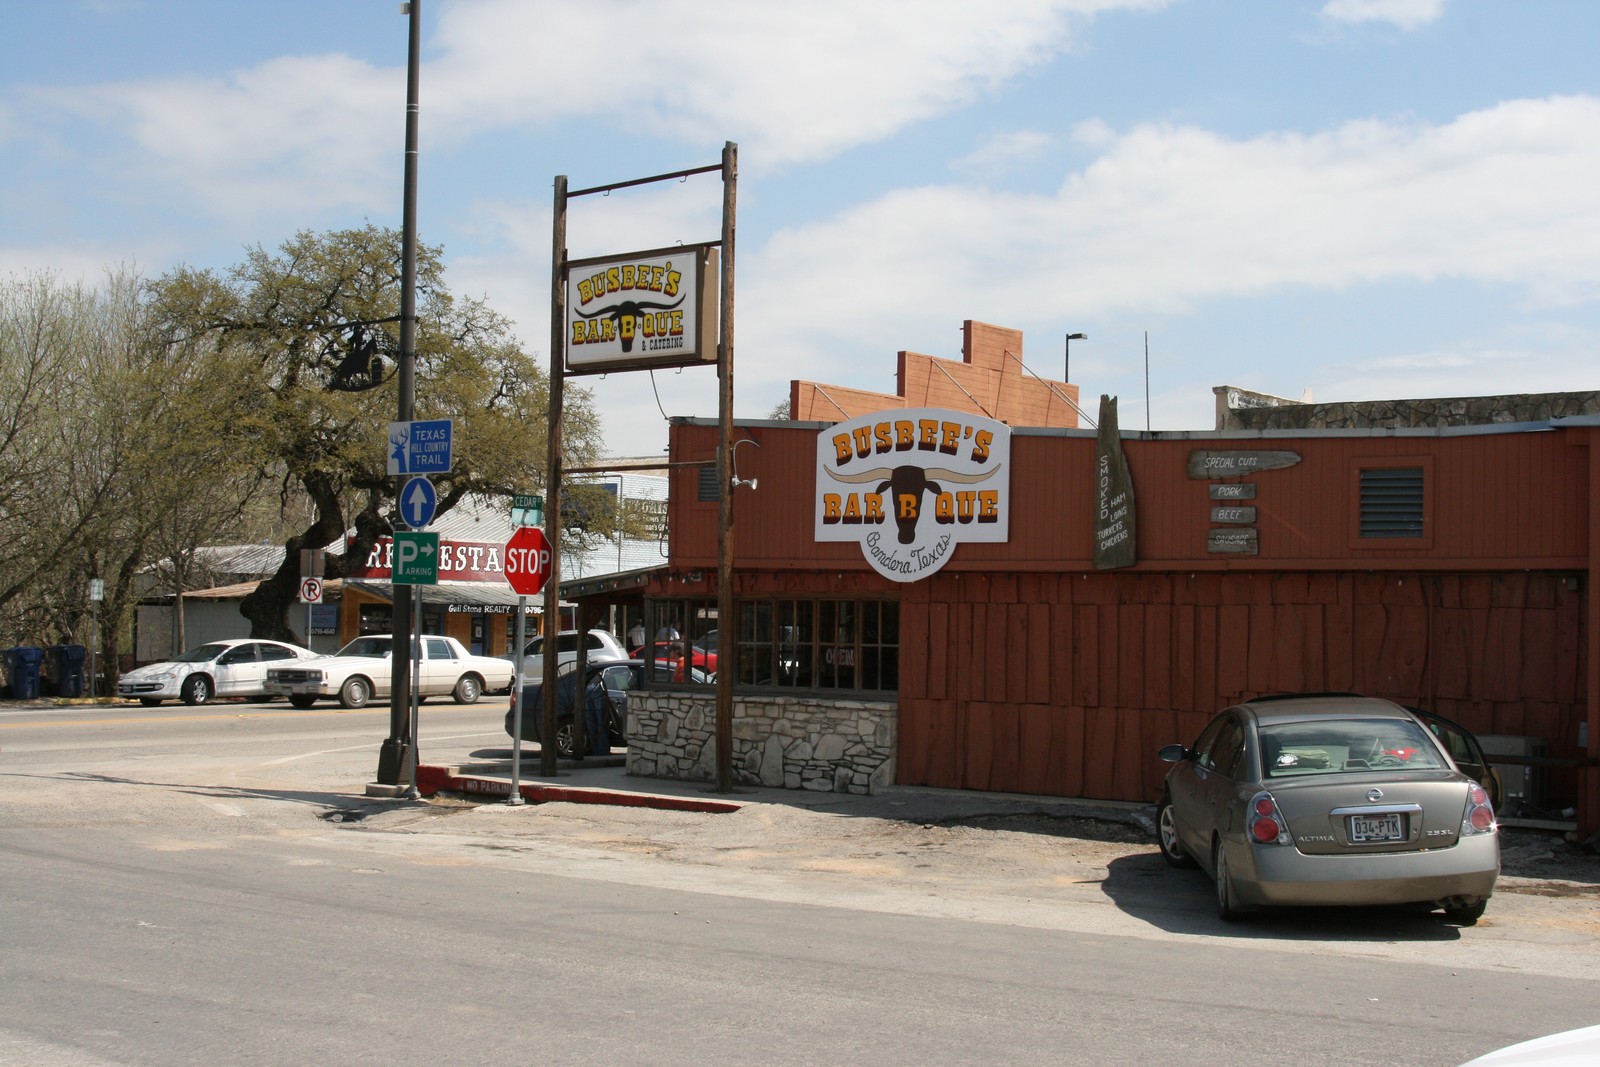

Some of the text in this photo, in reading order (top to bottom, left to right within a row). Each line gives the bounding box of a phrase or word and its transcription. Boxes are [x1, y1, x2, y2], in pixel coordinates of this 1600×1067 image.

[577, 261, 681, 306] BUSBEE'S
[649, 337, 683, 350] CATERING
[416, 430, 446, 441] TEXAS
[410, 441, 449, 453] HILL COUNTRY
[832, 418, 993, 467] BUSBEE'S
[416, 454, 443, 465] TRAIL
[1204, 457, 1258, 469] SPECIAL CUTS
[1217, 486, 1242, 497] PORK
[514, 496, 537, 508] CEDAR
[1110, 492, 1126, 508] HAM
[1218, 509, 1242, 520] BEEF
[1097, 521, 1123, 540] TURKEYS
[1100, 529, 1129, 551] CHICKENS
[1214, 534, 1249, 545] SAUSAGE
[910, 533, 951, 571] Texas
[507, 548, 550, 574] STOP
[448, 604, 461, 613] Gail
[463, 604, 482, 613] Stone
[484, 605, 510, 613] REALTY
[825, 648, 854, 666] OPEN
[481, 781, 512, 794] PARKIN
